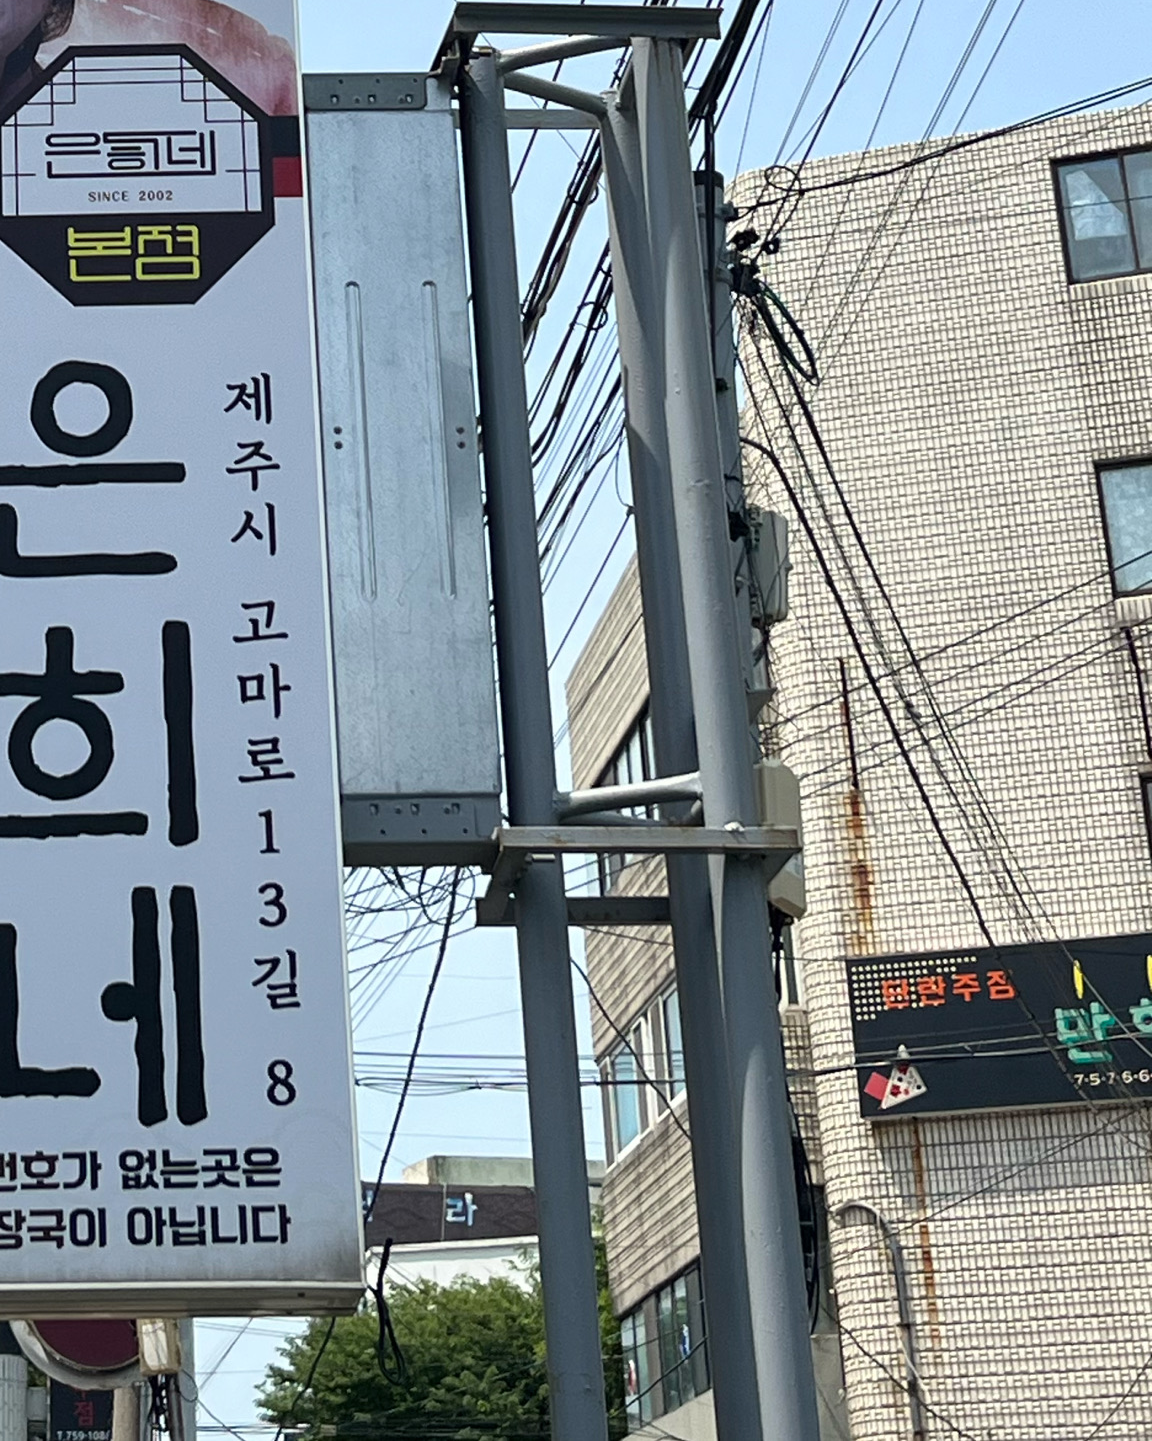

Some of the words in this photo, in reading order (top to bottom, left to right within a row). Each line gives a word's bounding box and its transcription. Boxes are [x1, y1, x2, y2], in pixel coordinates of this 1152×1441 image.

[87, 190, 130, 203] SINCE
[138, 189, 174, 202] 2002
[67, 224, 201, 283] 본점
[223, 371, 281, 557] 제주시
[266, 1058, 297, 1107] 8
[881, 971, 1016, 1008] 단란주점
[117, 1146, 283, 1190] 없는곳은
[126, 1203, 292, 1248] 아닙니다
